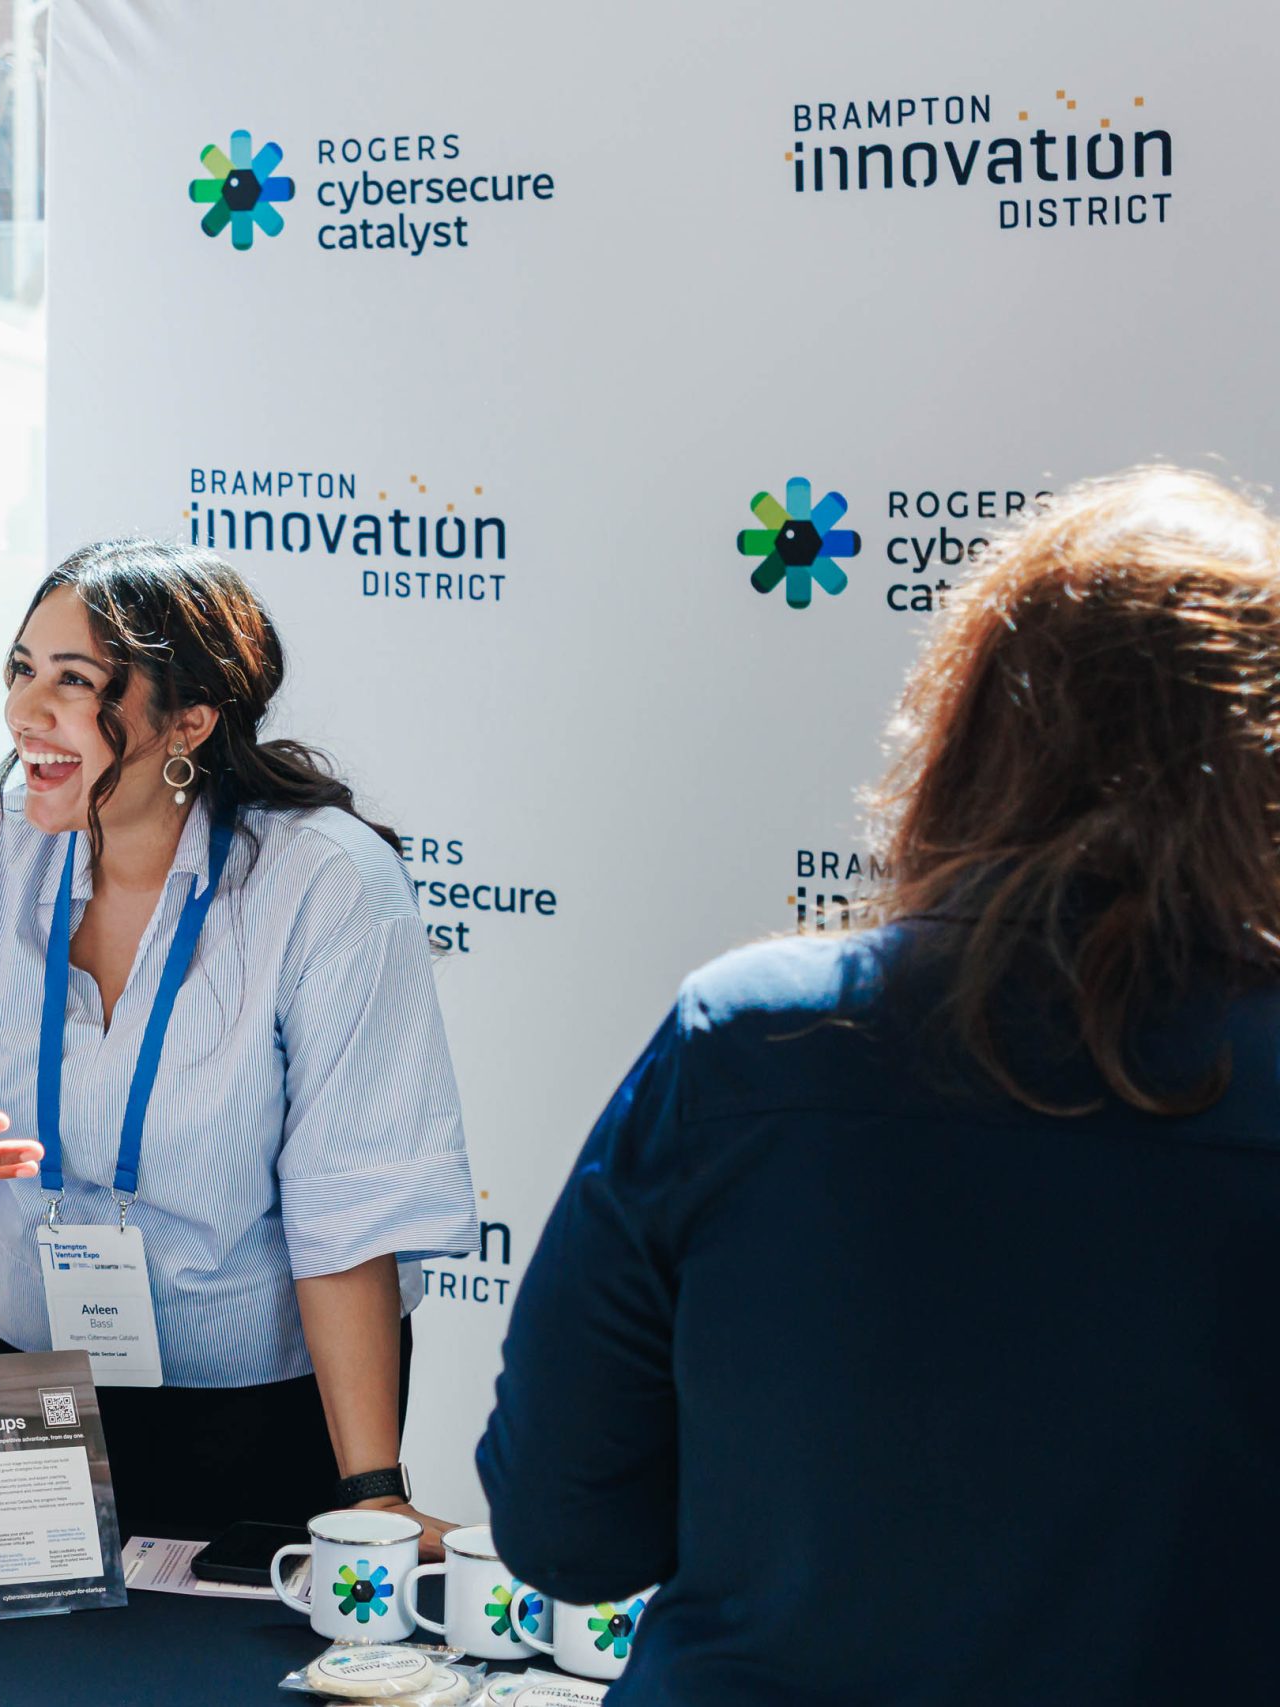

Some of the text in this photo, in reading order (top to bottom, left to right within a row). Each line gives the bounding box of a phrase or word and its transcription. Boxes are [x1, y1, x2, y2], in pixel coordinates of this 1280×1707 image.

[793, 94, 990, 132] BRAMPTON
[318, 134, 461, 164] ROGERS
[793, 129, 1173, 192] innovation
[317, 172, 555, 214] cybersecure
[999, 193, 1173, 229] DISTRICT
[317, 214, 469, 256] catalyst
[190, 468, 356, 500] BRAMPTON
[191, 502, 507, 560] innovation
[363, 570, 506, 601] DISTRICT
[399, 836, 464, 866] ERS
[797, 850, 894, 881] BRAM
[414, 879, 558, 916] rsecure
[422, 1269, 510, 1305] TRICT
[81, 1304, 118, 1315] Avleen
[90, 1318, 113, 1328] Bassi
[531, 1689, 601, 1702] novation
